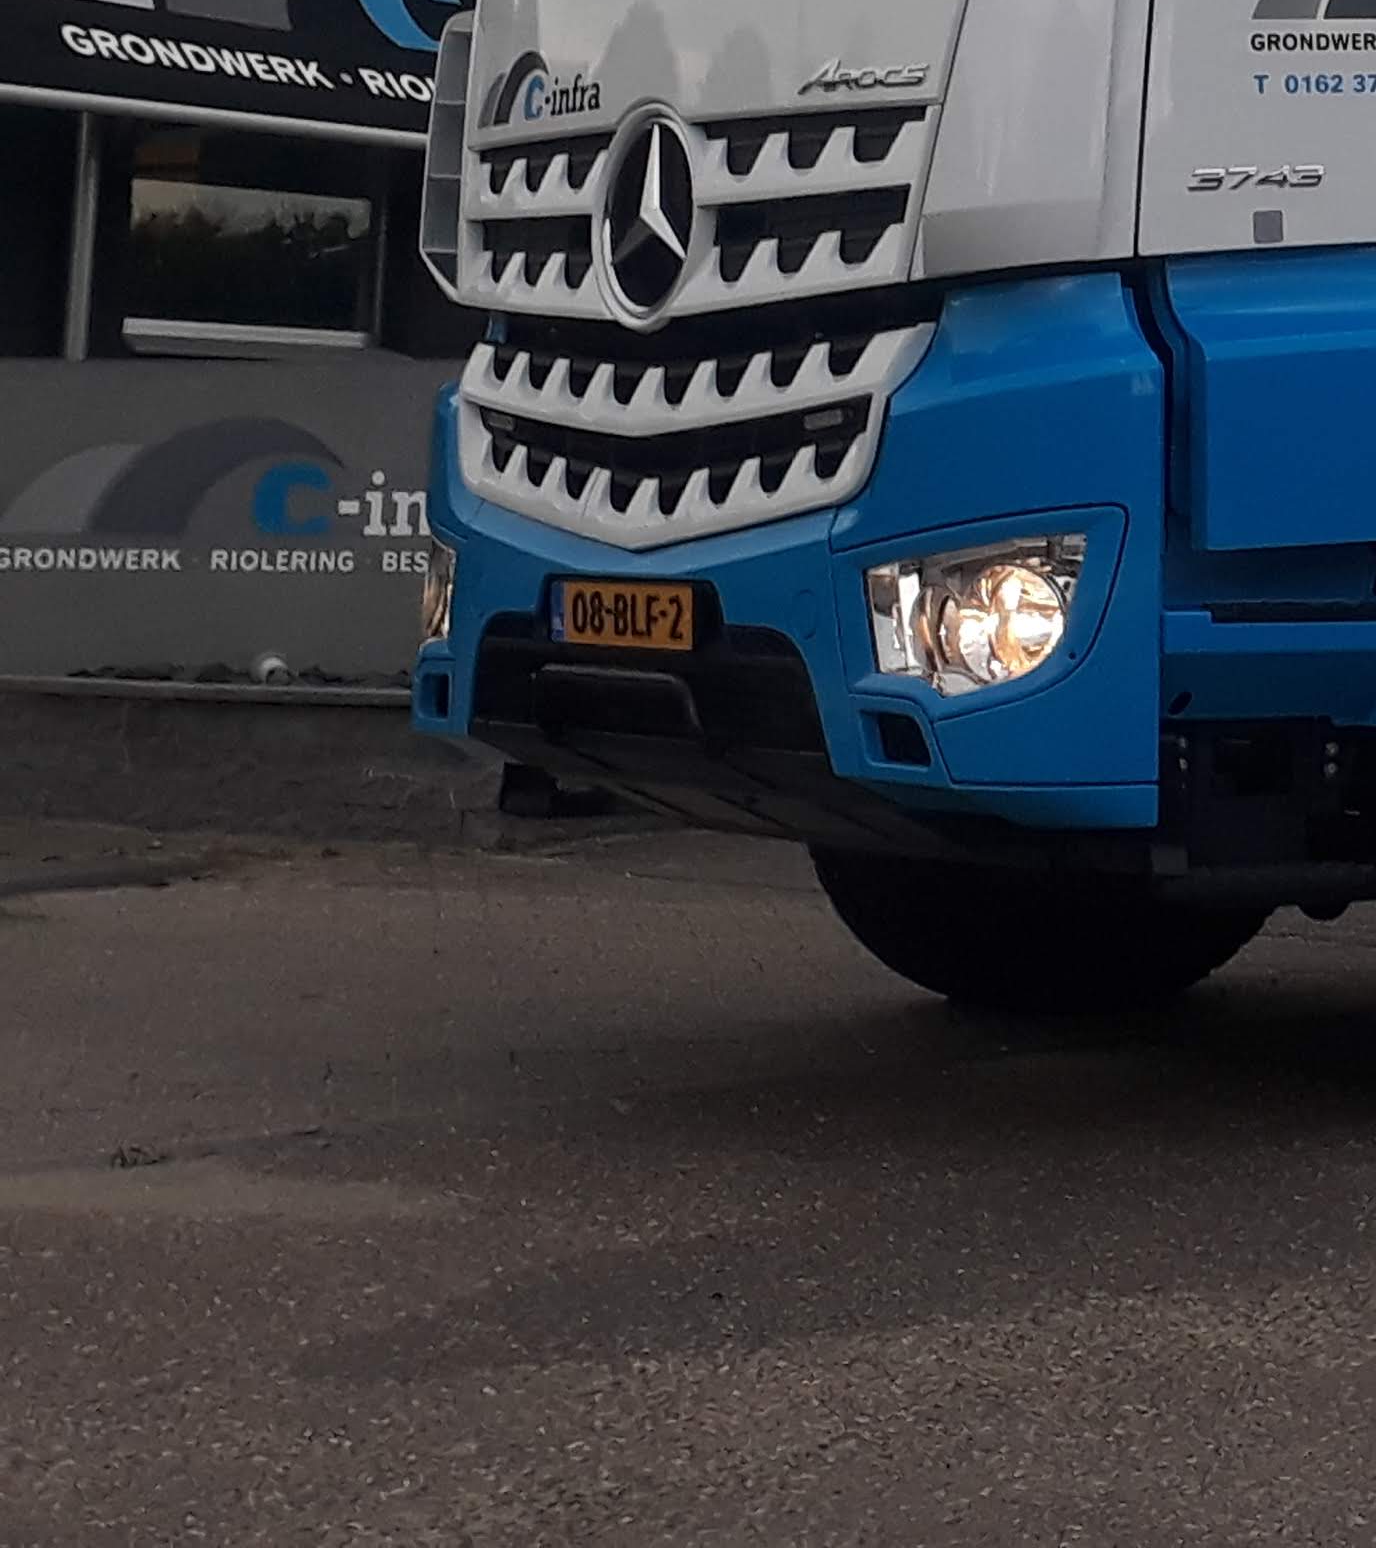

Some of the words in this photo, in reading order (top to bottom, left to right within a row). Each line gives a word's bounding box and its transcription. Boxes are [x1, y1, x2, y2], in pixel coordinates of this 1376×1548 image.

[61, 24, 336, 89] GRONDWERK
[358, 67, 435, 102] RIO
[524, 73, 600, 121] C-infra
[1254, 74, 1268, 94] T
[1284, 73, 1344, 94] 0162
[1187, 165, 1325, 192] 3743
[210, 549, 354, 572] RIOLERING
[572, 590, 683, 640] 08-BLF-2
